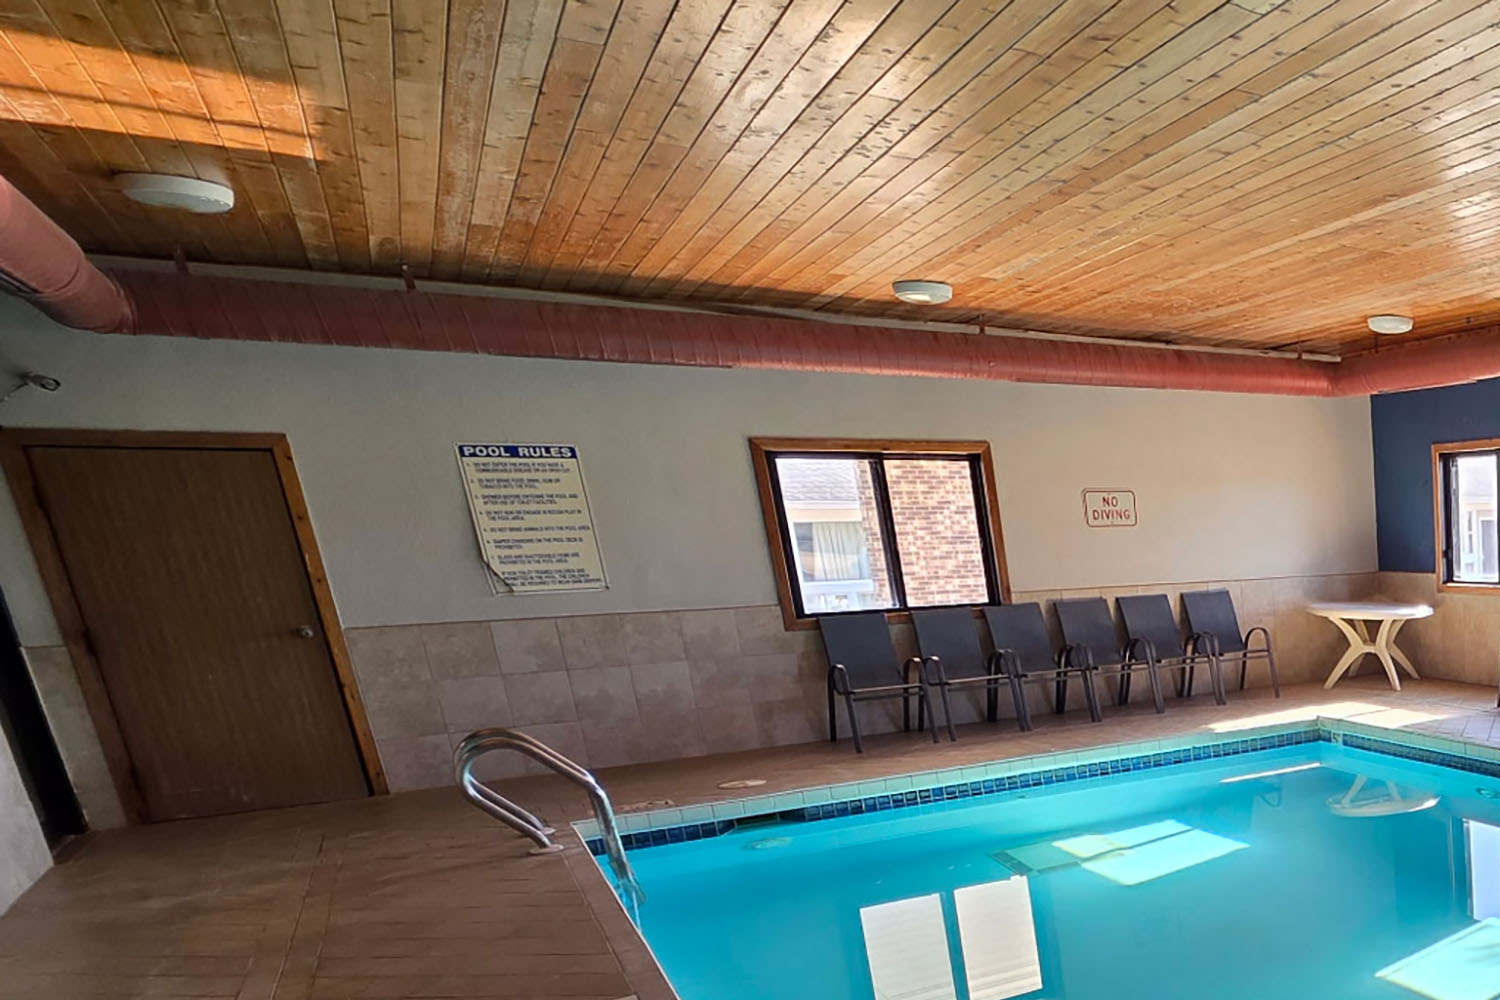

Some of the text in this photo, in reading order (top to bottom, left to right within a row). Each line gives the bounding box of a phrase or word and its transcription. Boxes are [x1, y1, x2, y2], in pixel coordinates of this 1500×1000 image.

[463, 446, 572, 458] POOL RULES
[1102, 496, 1118, 507] NO
[1092, 509, 1131, 520] DIVING
